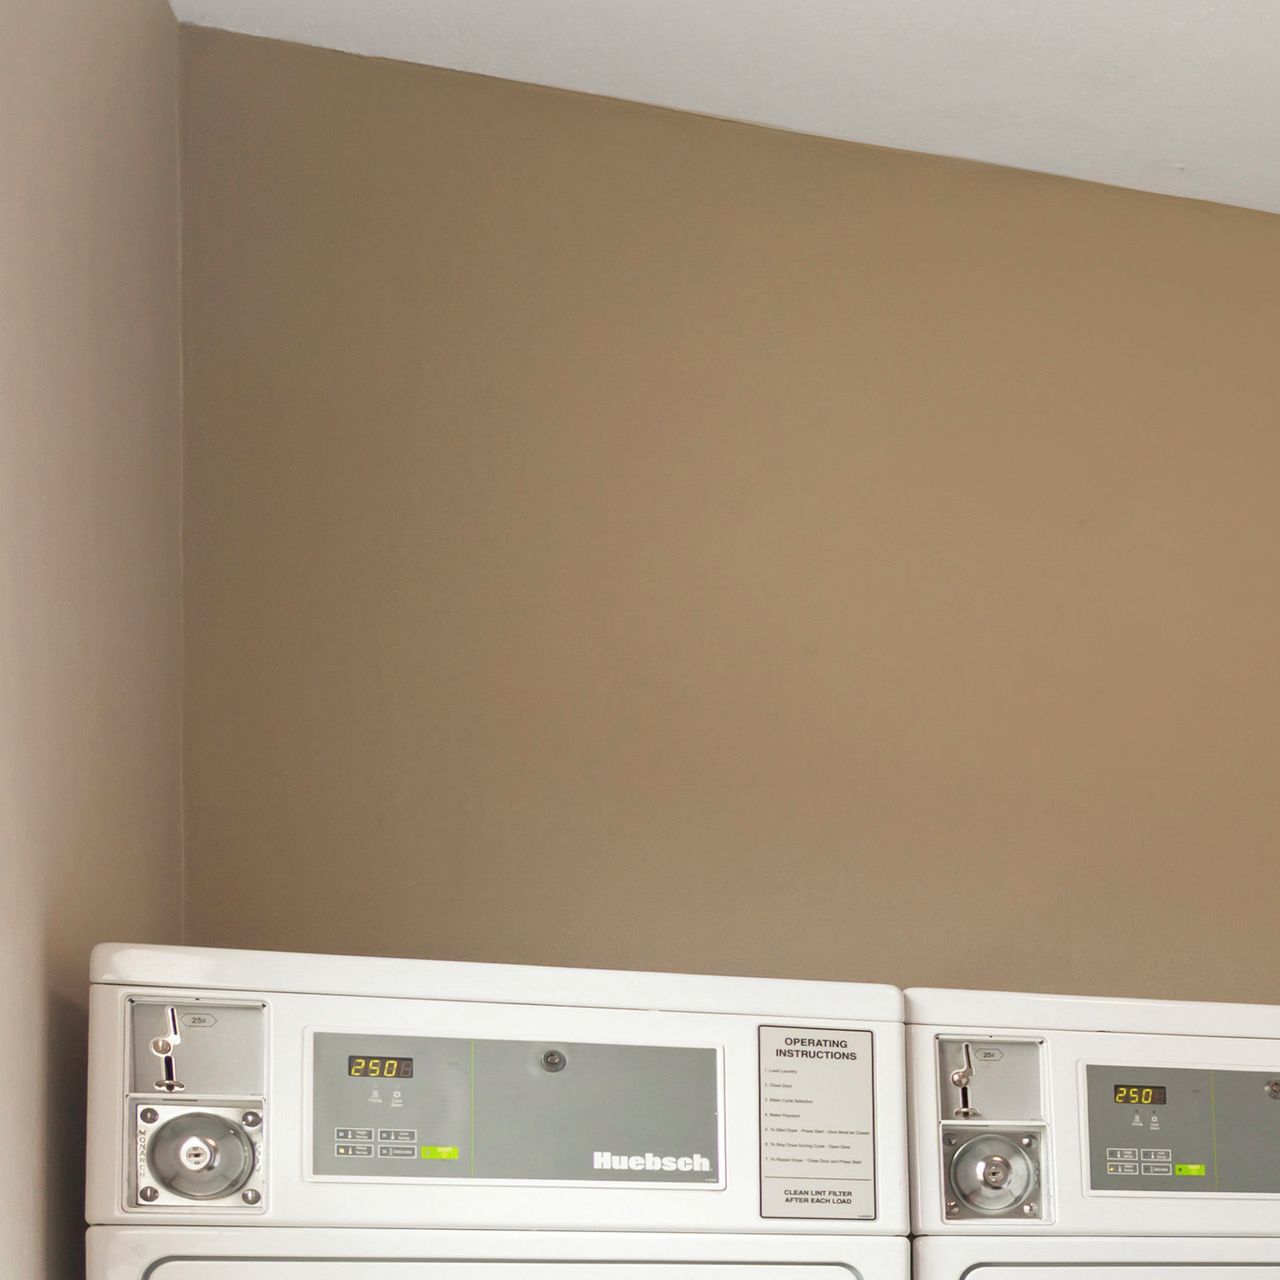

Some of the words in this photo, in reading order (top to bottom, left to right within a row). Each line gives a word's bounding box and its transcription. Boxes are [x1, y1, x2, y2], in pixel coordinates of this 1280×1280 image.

[784, 1037, 848, 1048] OPERATING
[775, 1048, 857, 1061] INSTRUCTIONS
[593, 1151, 711, 1171] Huebsch
[828, 1190, 852, 1198] FILTER
